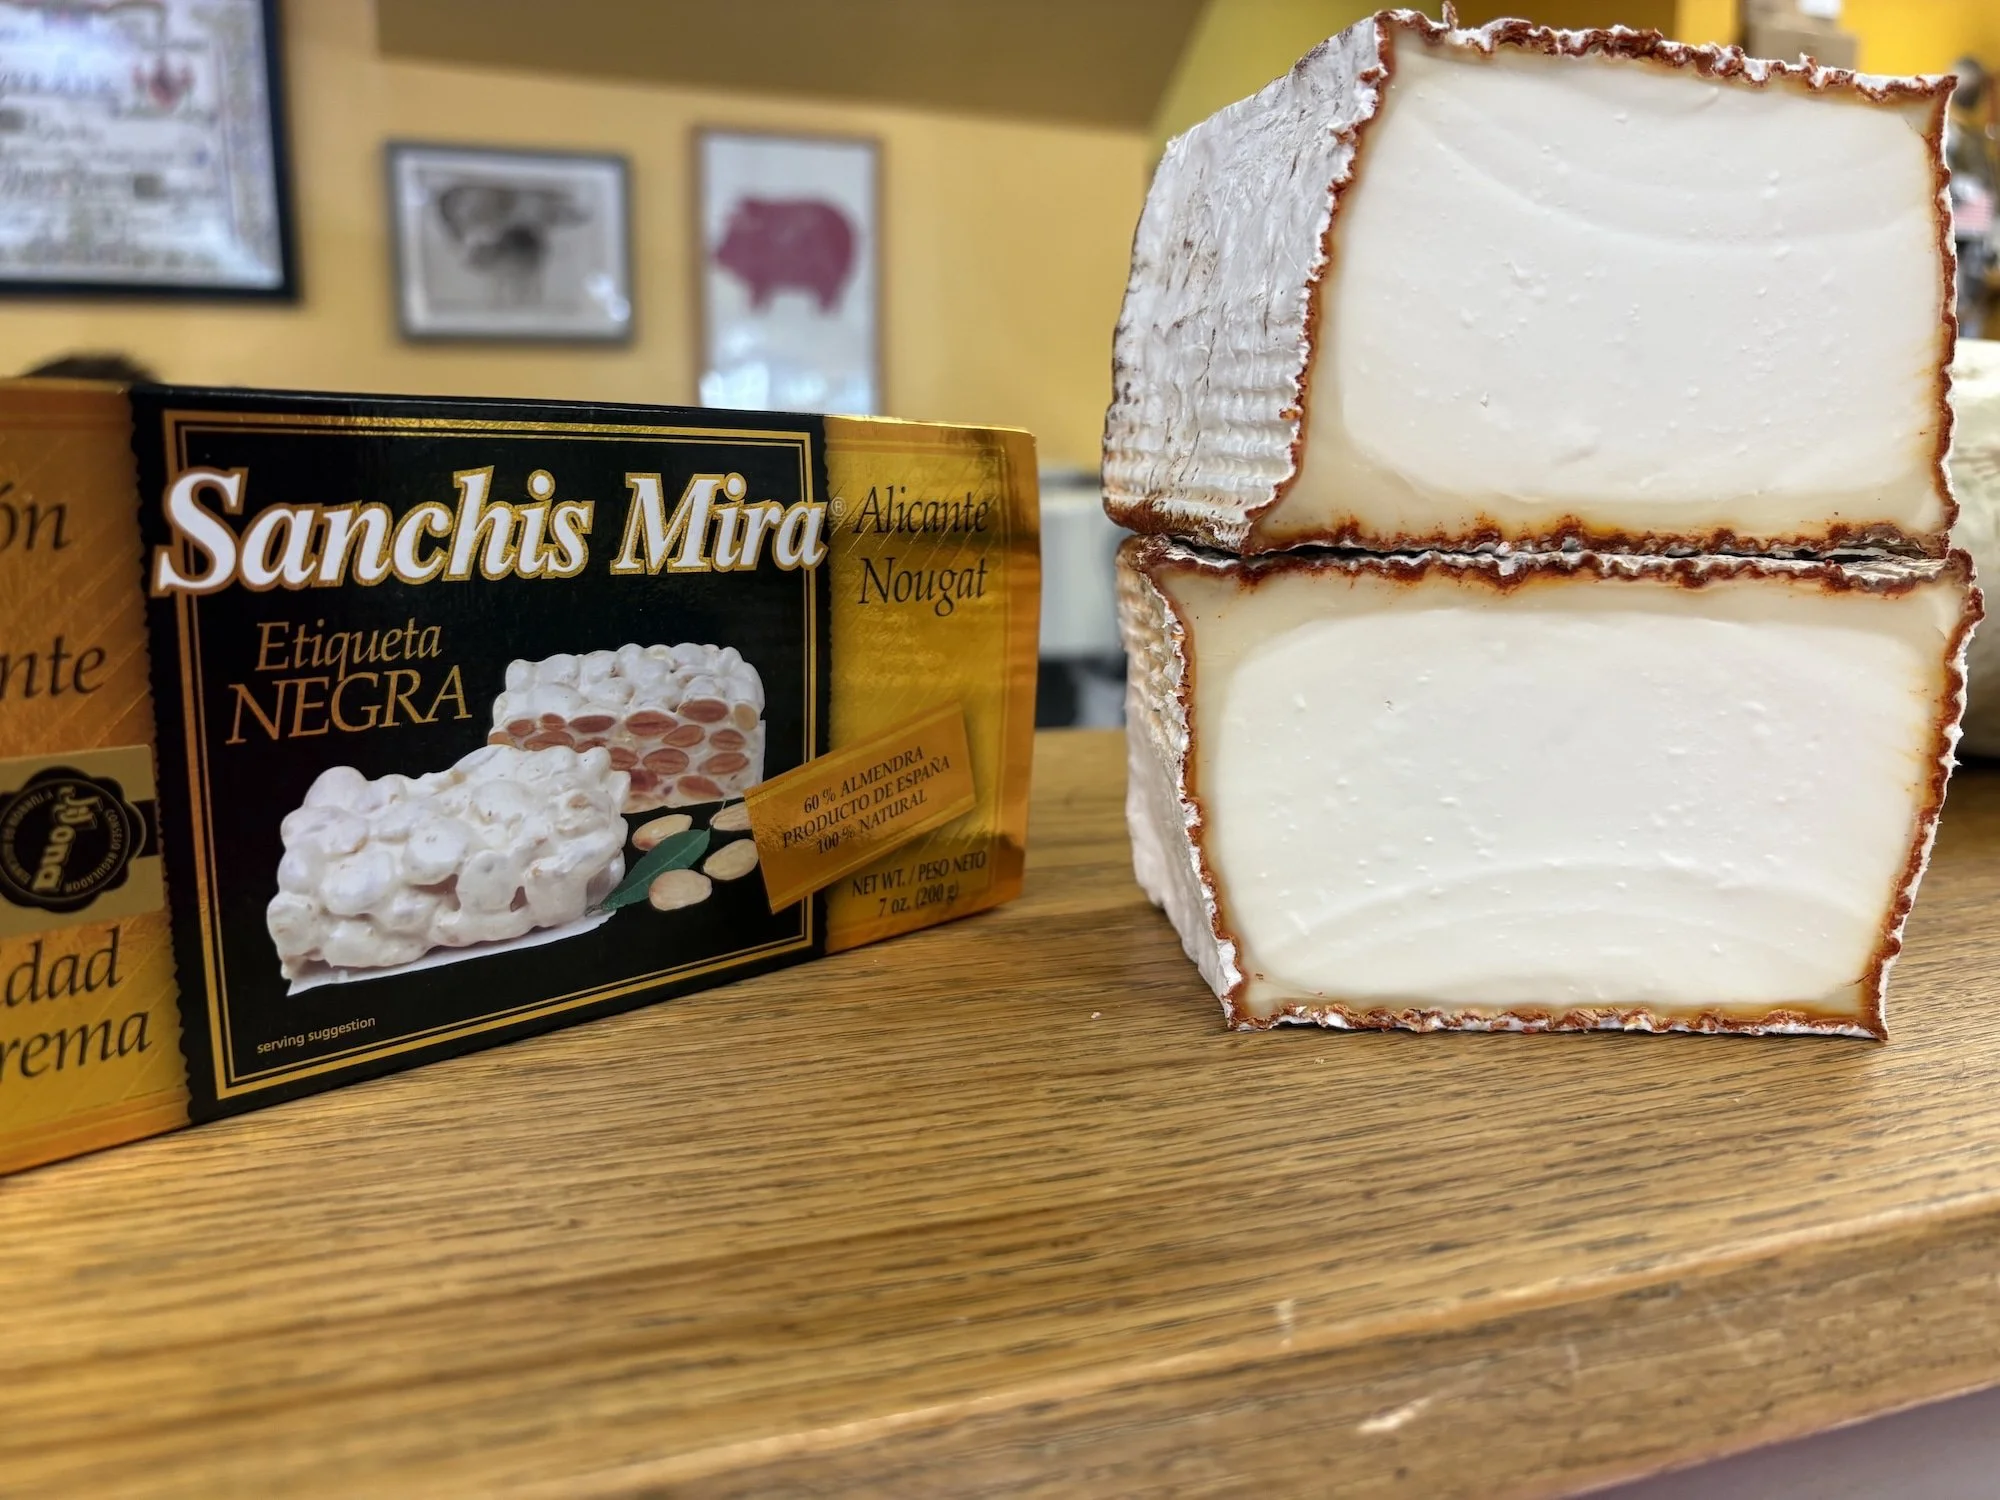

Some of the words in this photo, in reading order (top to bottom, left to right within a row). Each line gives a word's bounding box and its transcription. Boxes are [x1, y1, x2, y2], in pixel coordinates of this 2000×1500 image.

[150, 465, 595, 597] Sanchis
[852, 485, 990, 534] Alicante
[858, 557, 988, 617] Nougat
[254, 616, 442, 680] Etiqueta
[225, 664, 473, 744] NEGRA
[783, 794, 870, 849] PRODUCTO
[873, 783, 894, 804] DE
[897, 755, 950, 793] ESPAÑA
[804, 795, 820, 814] 60
[822, 785, 836, 804] %
[841, 746, 924, 798] ALMENDRA
[816, 831, 840, 854] 100
[842, 824, 857, 839] %
[860, 789, 928, 834] NATURAL
[852, 874, 878, 897] NET
[882, 868, 905, 890] WT.
[918, 858, 949, 882] PESO
[954, 850, 986, 872] NETO
[878, 897, 887, 917] 7
[892, 897, 910, 914] oz.
[256, 1034, 305, 1054] serving
[308, 1017, 376, 1041] suggestion
